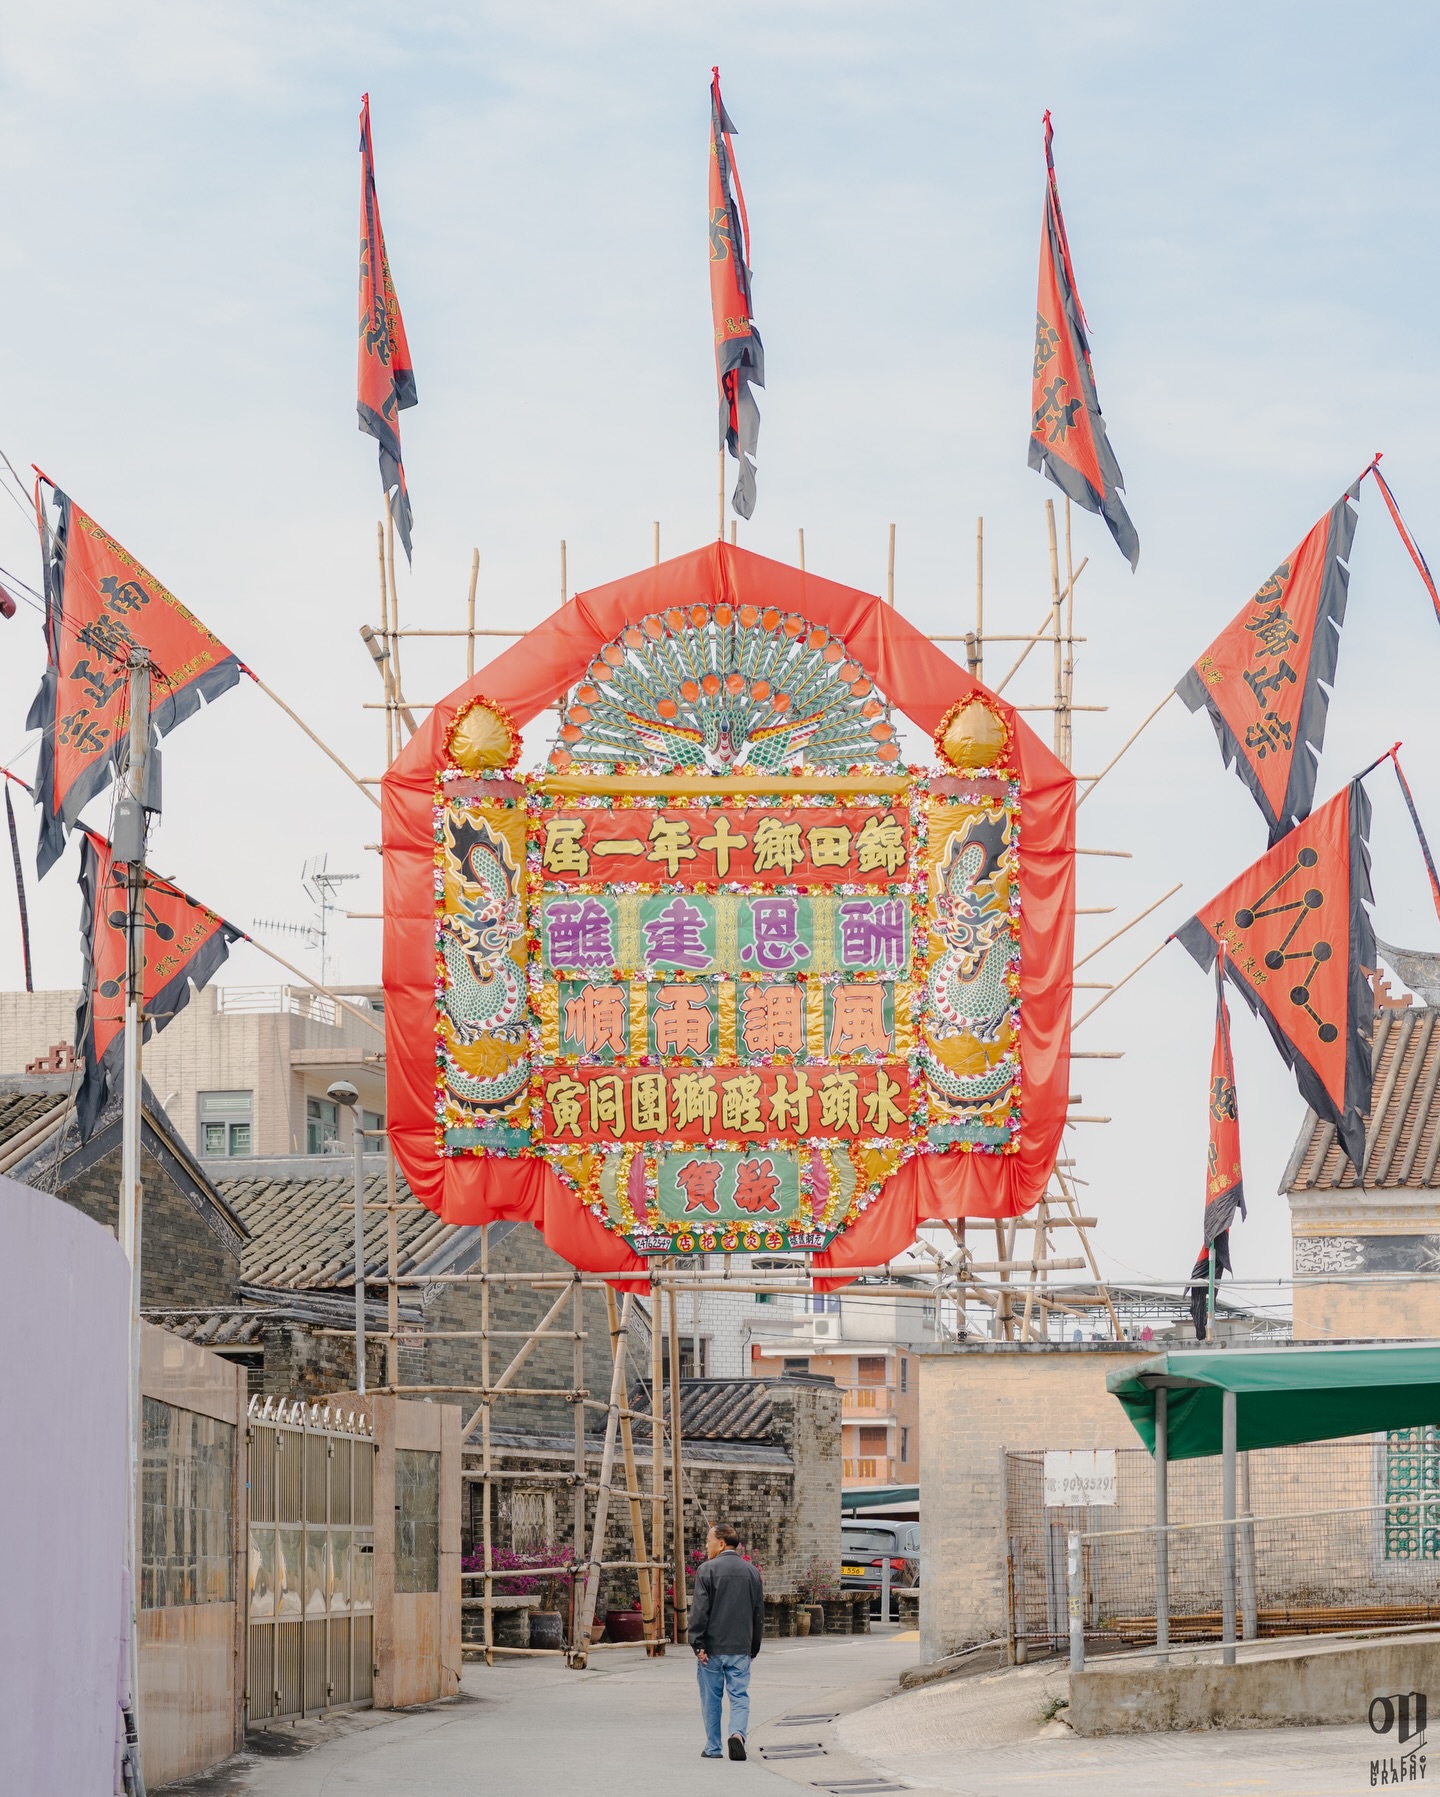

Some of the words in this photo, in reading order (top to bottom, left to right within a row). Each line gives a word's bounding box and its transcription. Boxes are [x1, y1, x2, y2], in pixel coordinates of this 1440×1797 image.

[57, 574, 152, 755] 南獅正宗
[544, 897, 908, 968] 酬恩建醮
[565, 982, 896, 1056] 風調雨順
[544, 1072, 912, 1138] 水頭村醒獅團同寅
[676, 1157, 782, 1214] 敬賀
[635, 1238, 671, 1250] 24762549
[679, 1232, 782, 1250] 李炎記花店
